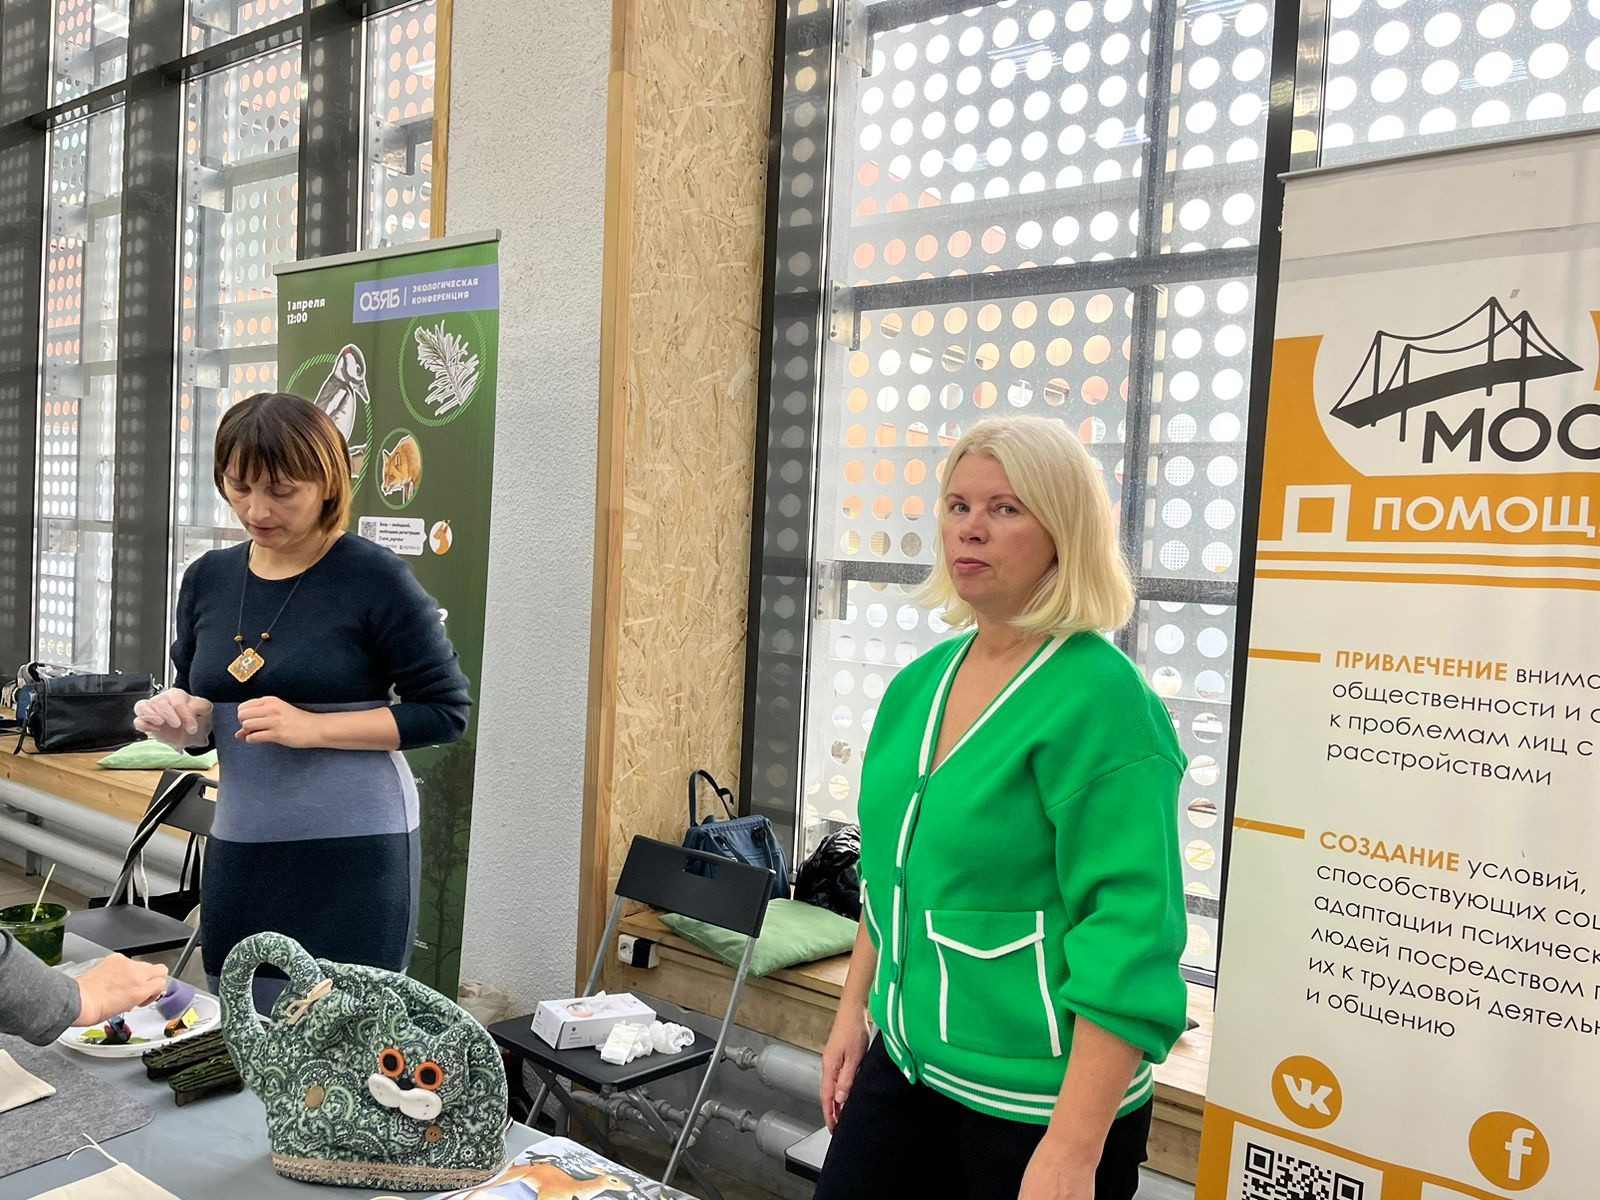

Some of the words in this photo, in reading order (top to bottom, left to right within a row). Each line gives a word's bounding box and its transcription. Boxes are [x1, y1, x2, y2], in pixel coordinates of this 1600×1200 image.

[359, 287, 401, 312] ОЗЯБ
[411, 290, 470, 305] КОНФЕРЕНЦИЯ
[412, 277, 479, 293] ЭКОЛОГИЧЕСКАЯ
[286, 312, 308, 325] 12:00
[1372, 495, 1600, 538] ПОМОЩ
[1335, 650, 1508, 682] ПРИВЛЕЧЕНИЕ
[1332, 681, 1555, 719] общественности
[1565, 705, 1581, 721] и
[1330, 713, 1341, 728] к
[1348, 715, 1510, 747] проблемам
[1517, 735, 1568, 756] лиц
[1576, 740, 1594, 756] с
[1326, 743, 1551, 786] расстройствами
[1319, 830, 1460, 872] СОЗДАНИЕ
[1467, 859, 1586, 895] условий,
[1316, 865, 1547, 923] способствующих
[1314, 896, 1453, 937] адаптации
[1309, 957, 1335, 977] их
[1342, 965, 1354, 981] к
[1360, 969, 1481, 1010] трудовой
[1310, 927, 1390, 958] людей
[1398, 946, 1584, 998] посредством
[1306, 988, 1320, 1004] и
[1327, 994, 1455, 1038] общению
